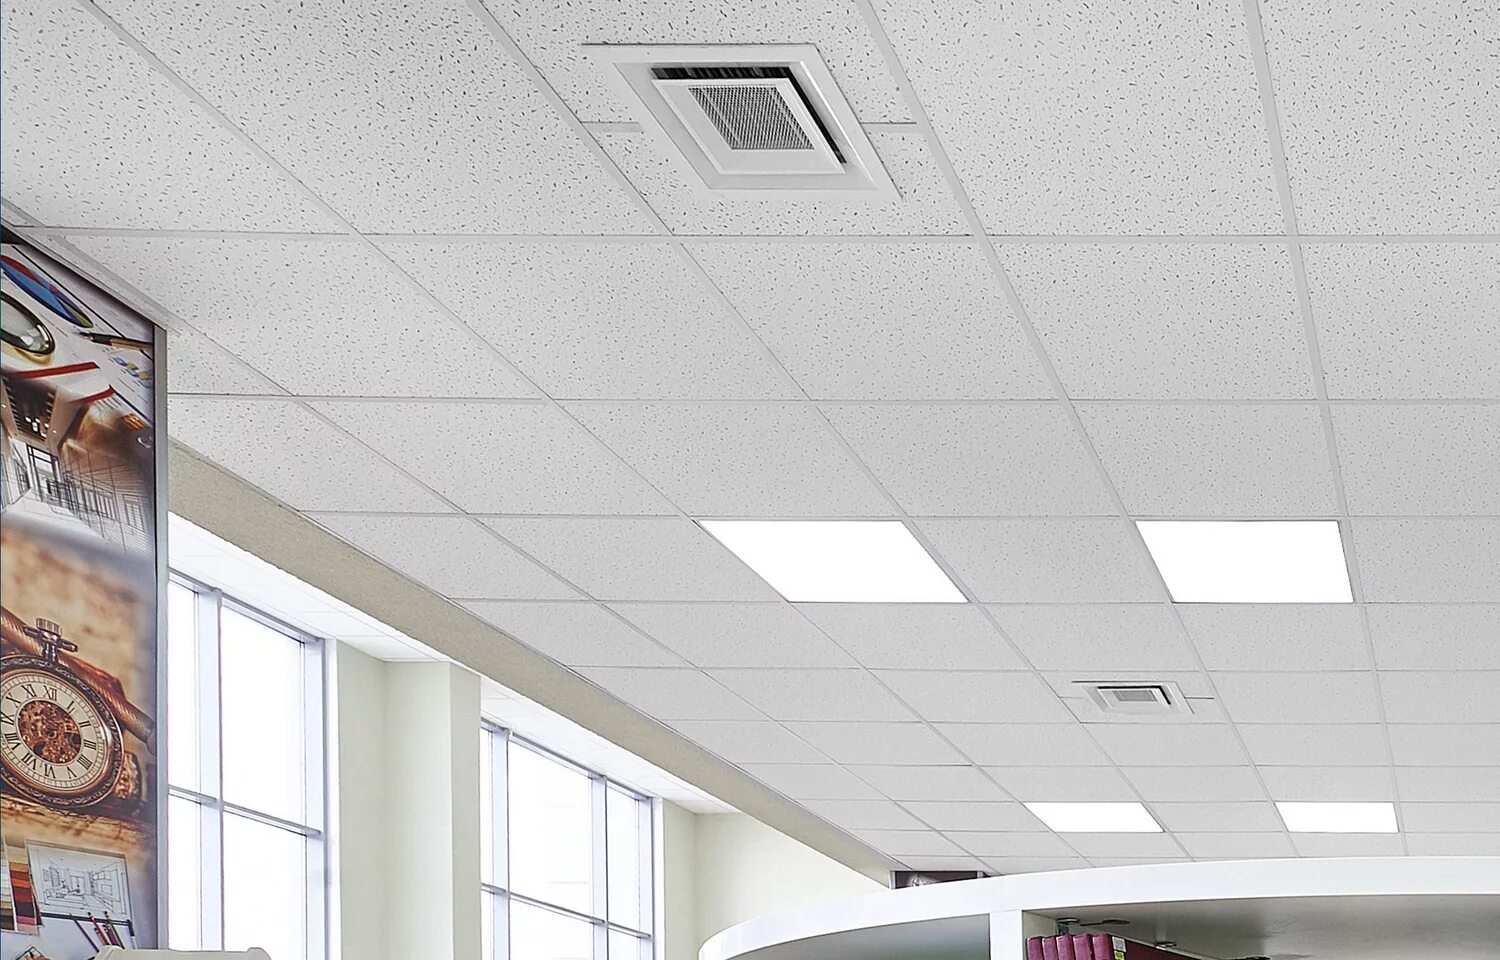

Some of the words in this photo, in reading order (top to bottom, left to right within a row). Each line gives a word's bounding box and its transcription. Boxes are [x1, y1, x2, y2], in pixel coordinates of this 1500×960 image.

[21, 684, 37, 698] XI
[43, 686, 58, 702] XII
[79, 720, 91, 728] II
[84, 739, 96, 750] III
